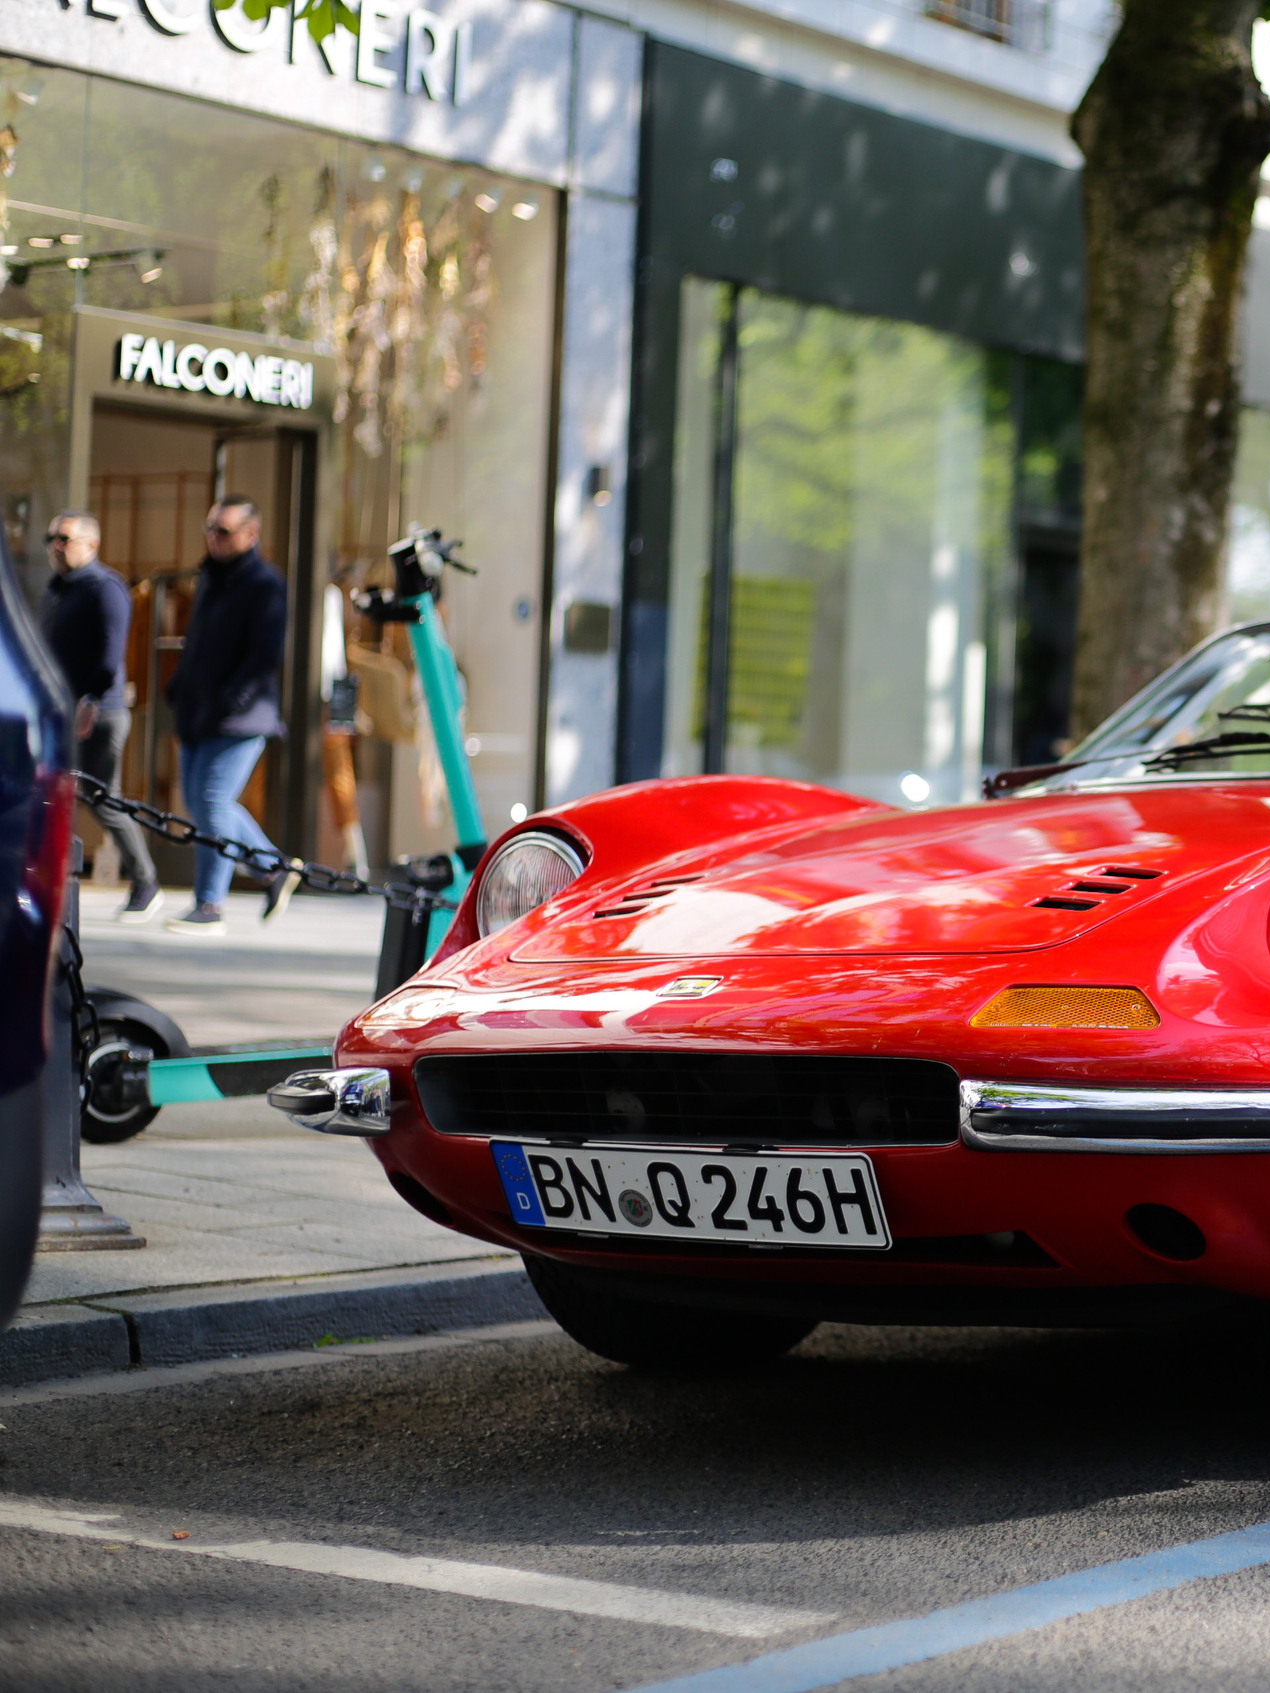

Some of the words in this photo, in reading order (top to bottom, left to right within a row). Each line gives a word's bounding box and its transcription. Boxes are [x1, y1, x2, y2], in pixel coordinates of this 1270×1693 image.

[119, 333, 314, 410] FALCONERI
[516, 1192, 531, 1210] D
[528, 1154, 616, 1223] BN
